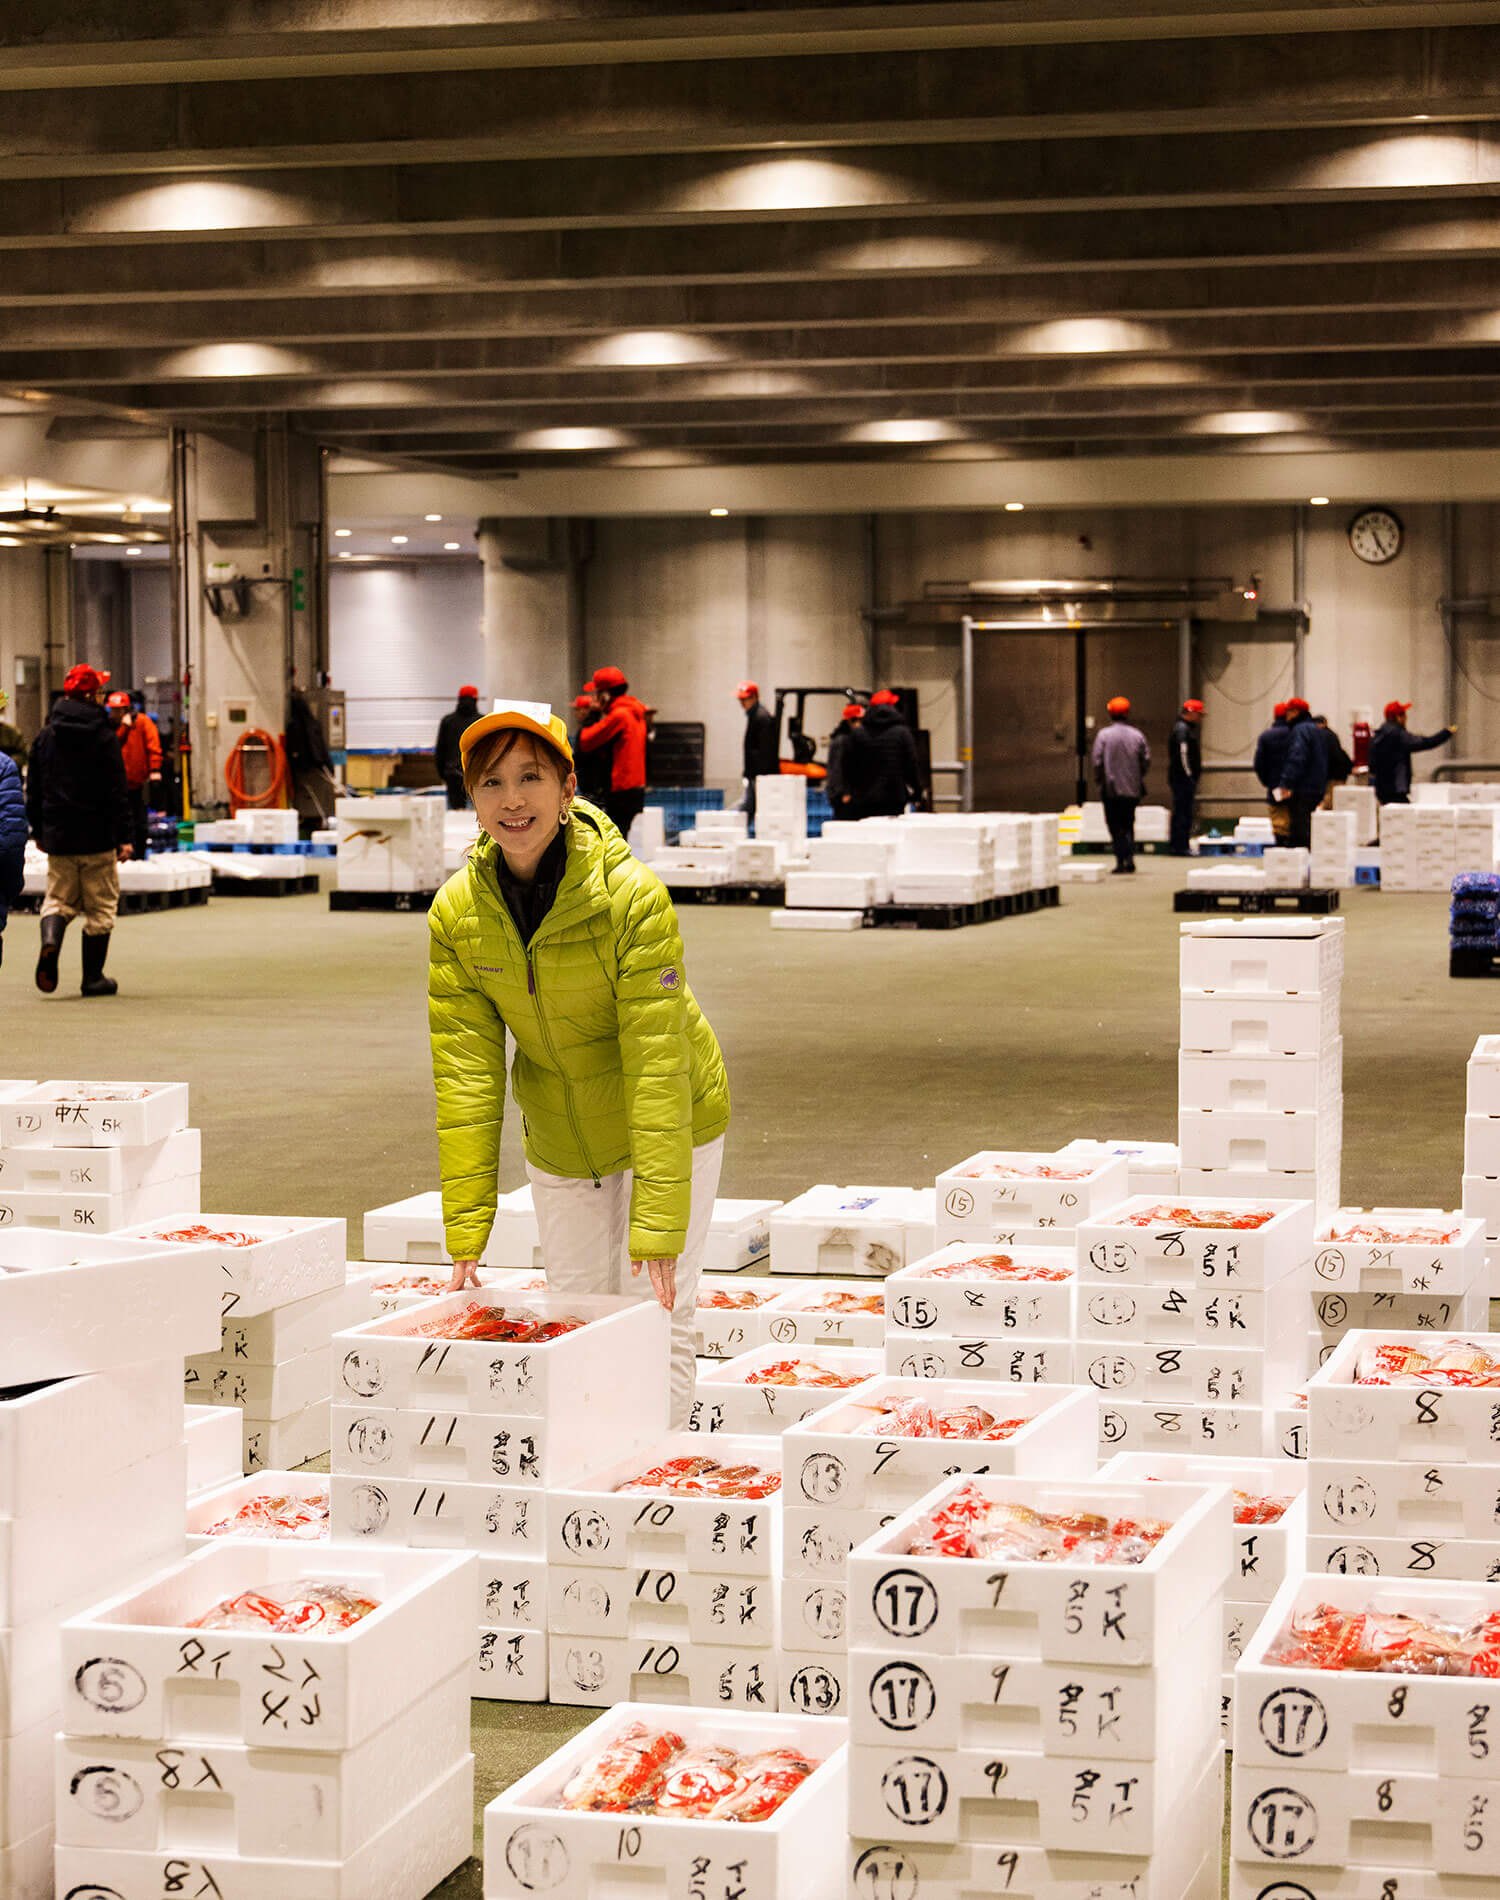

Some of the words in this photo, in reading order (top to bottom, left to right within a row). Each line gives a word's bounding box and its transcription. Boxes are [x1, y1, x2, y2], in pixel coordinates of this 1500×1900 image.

[473, 964, 504, 973] MAMMUT
[55, 1103, 89, 1124] 中大
[70, 1168, 92, 1183] 5K
[950, 1192, 969, 1210] 15
[1059, 1193, 1078, 1207] 10
[73, 1210, 95, 1224] 5K
[1099, 1245, 1127, 1267] 15
[1155, 1230, 1186, 1257] 8
[1202, 1258, 1240, 1277] 5K
[1321, 1255, 1340, 1273] 15
[1431, 1258, 1444, 1275] 4
[901, 1301, 928, 1324] 15
[1319, 1302, 1340, 1324] 15
[728, 1328, 744, 1342] 13
[777, 1322, 792, 1337] 15
[959, 1341, 989, 1368] 8
[1156, 1350, 1182, 1373] 8
[1098, 1362, 1126, 1385] 15
[1416, 1390, 1442, 1424] 8
[420, 1416, 457, 1446] 11
[1154, 1412, 1182, 1431] 8
[812, 1463, 841, 1495] 13
[413, 1487, 445, 1517] 11
[633, 1501, 674, 1526] 10
[571, 1516, 602, 1549] 13
[1407, 1541, 1445, 1571] 8
[635, 1569, 675, 1602] 10
[885, 1584, 924, 1626] 17
[1064, 1606, 1126, 1640] 5K
[177, 1638, 231, 1680] タイ
[638, 1646, 679, 1674] 10
[719, 1679, 767, 1703] 5K
[797, 1674, 833, 1708] 13
[881, 1678, 919, 1719] 17
[1388, 1685, 1408, 1718] 8
[1059, 1708, 1120, 1742] 5K
[1272, 1703, 1313, 1744] 17
[893, 1772, 931, 1815] 17
[1376, 1779, 1396, 1812] 8
[1072, 1794, 1133, 1828] 5K
[1262, 1803, 1303, 1846] 17
[618, 1826, 642, 1860] 10
[997, 1851, 1019, 1888] 9
